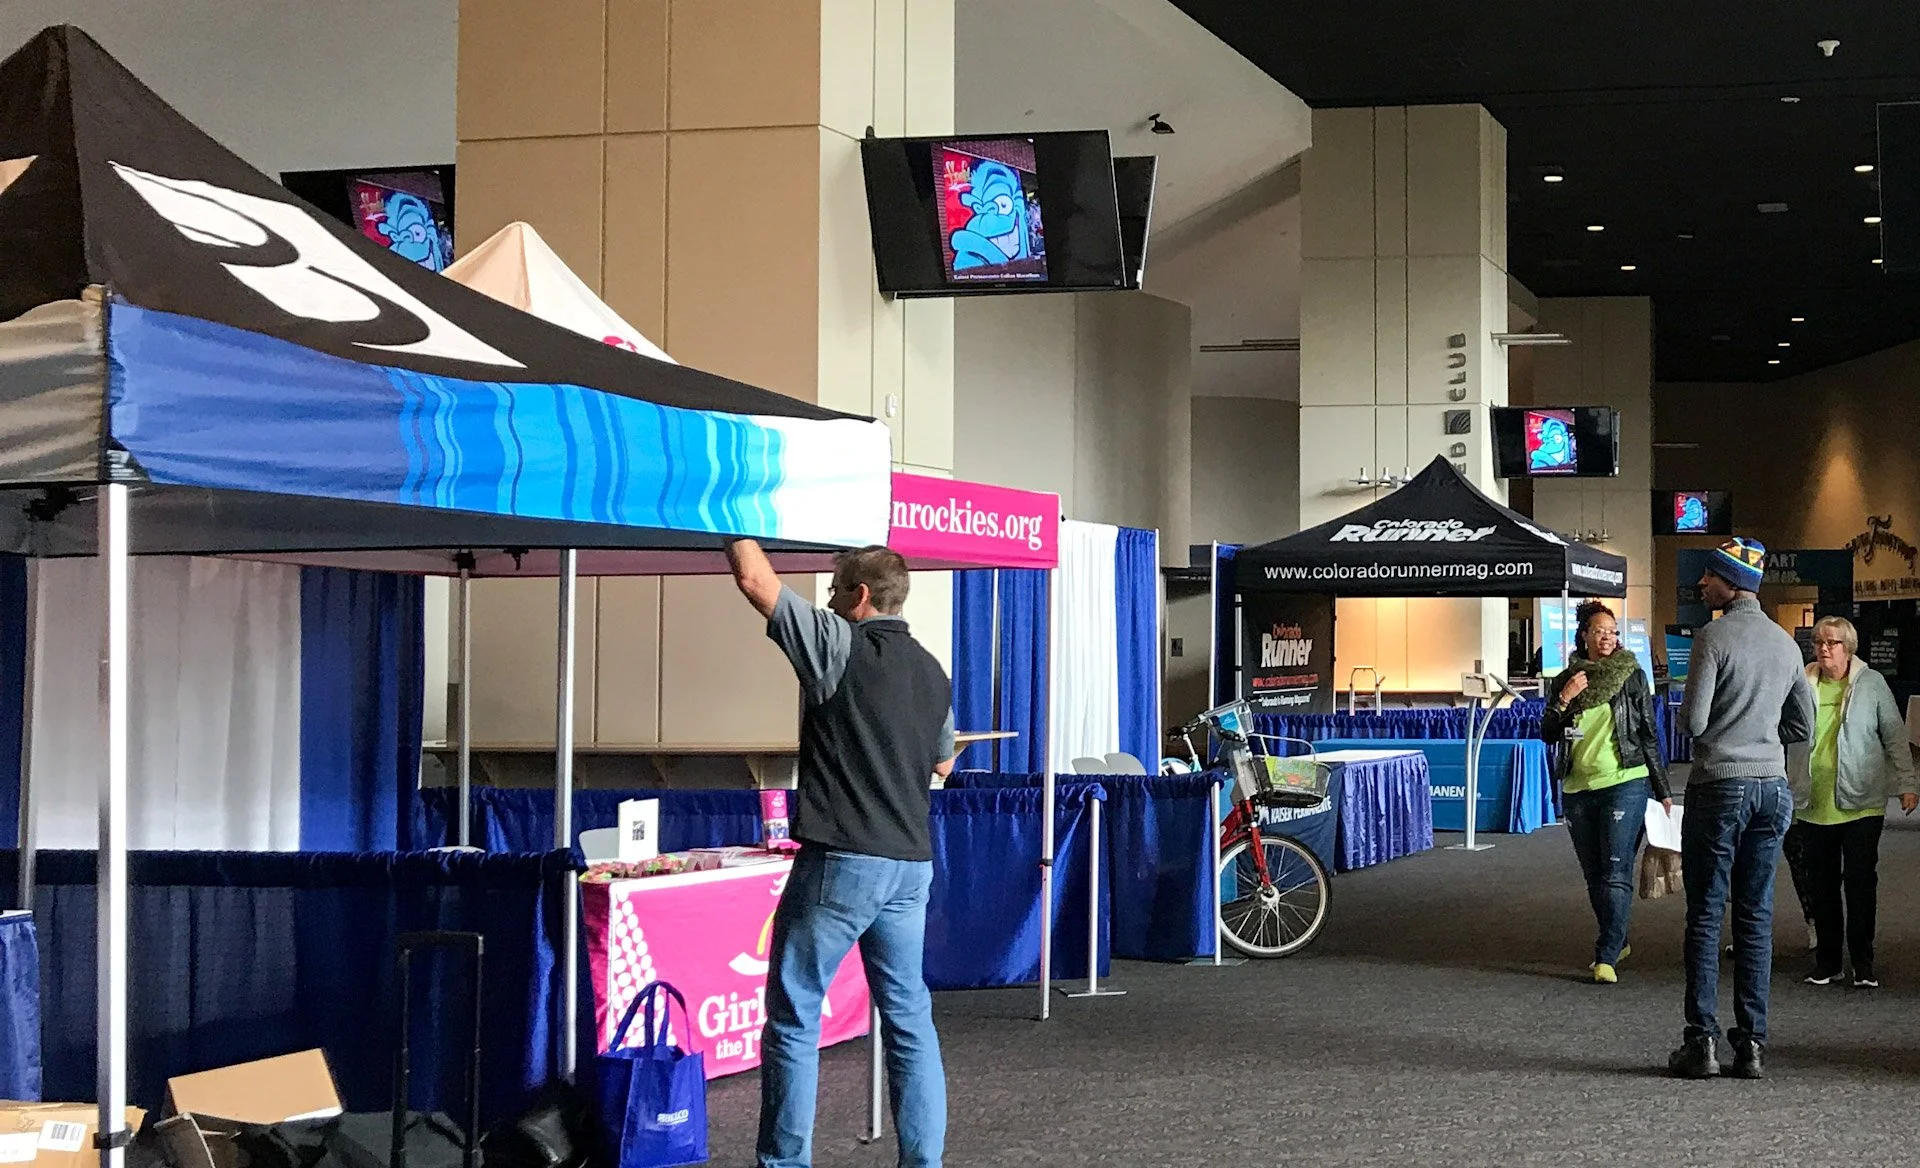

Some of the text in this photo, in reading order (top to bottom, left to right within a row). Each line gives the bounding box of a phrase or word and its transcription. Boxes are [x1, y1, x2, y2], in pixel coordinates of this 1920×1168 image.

[1448, 333, 1467, 401] CLUB
[892, 498, 1043, 551] nrockies.org
[1329, 524, 1497, 543] Runner
[1373, 518, 1465, 530] Colorado
[1264, 561, 1534, 580] www.coloradorunnermag.com
[1260, 632, 1314, 668] Runner
[715, 1038, 743, 1060] the
